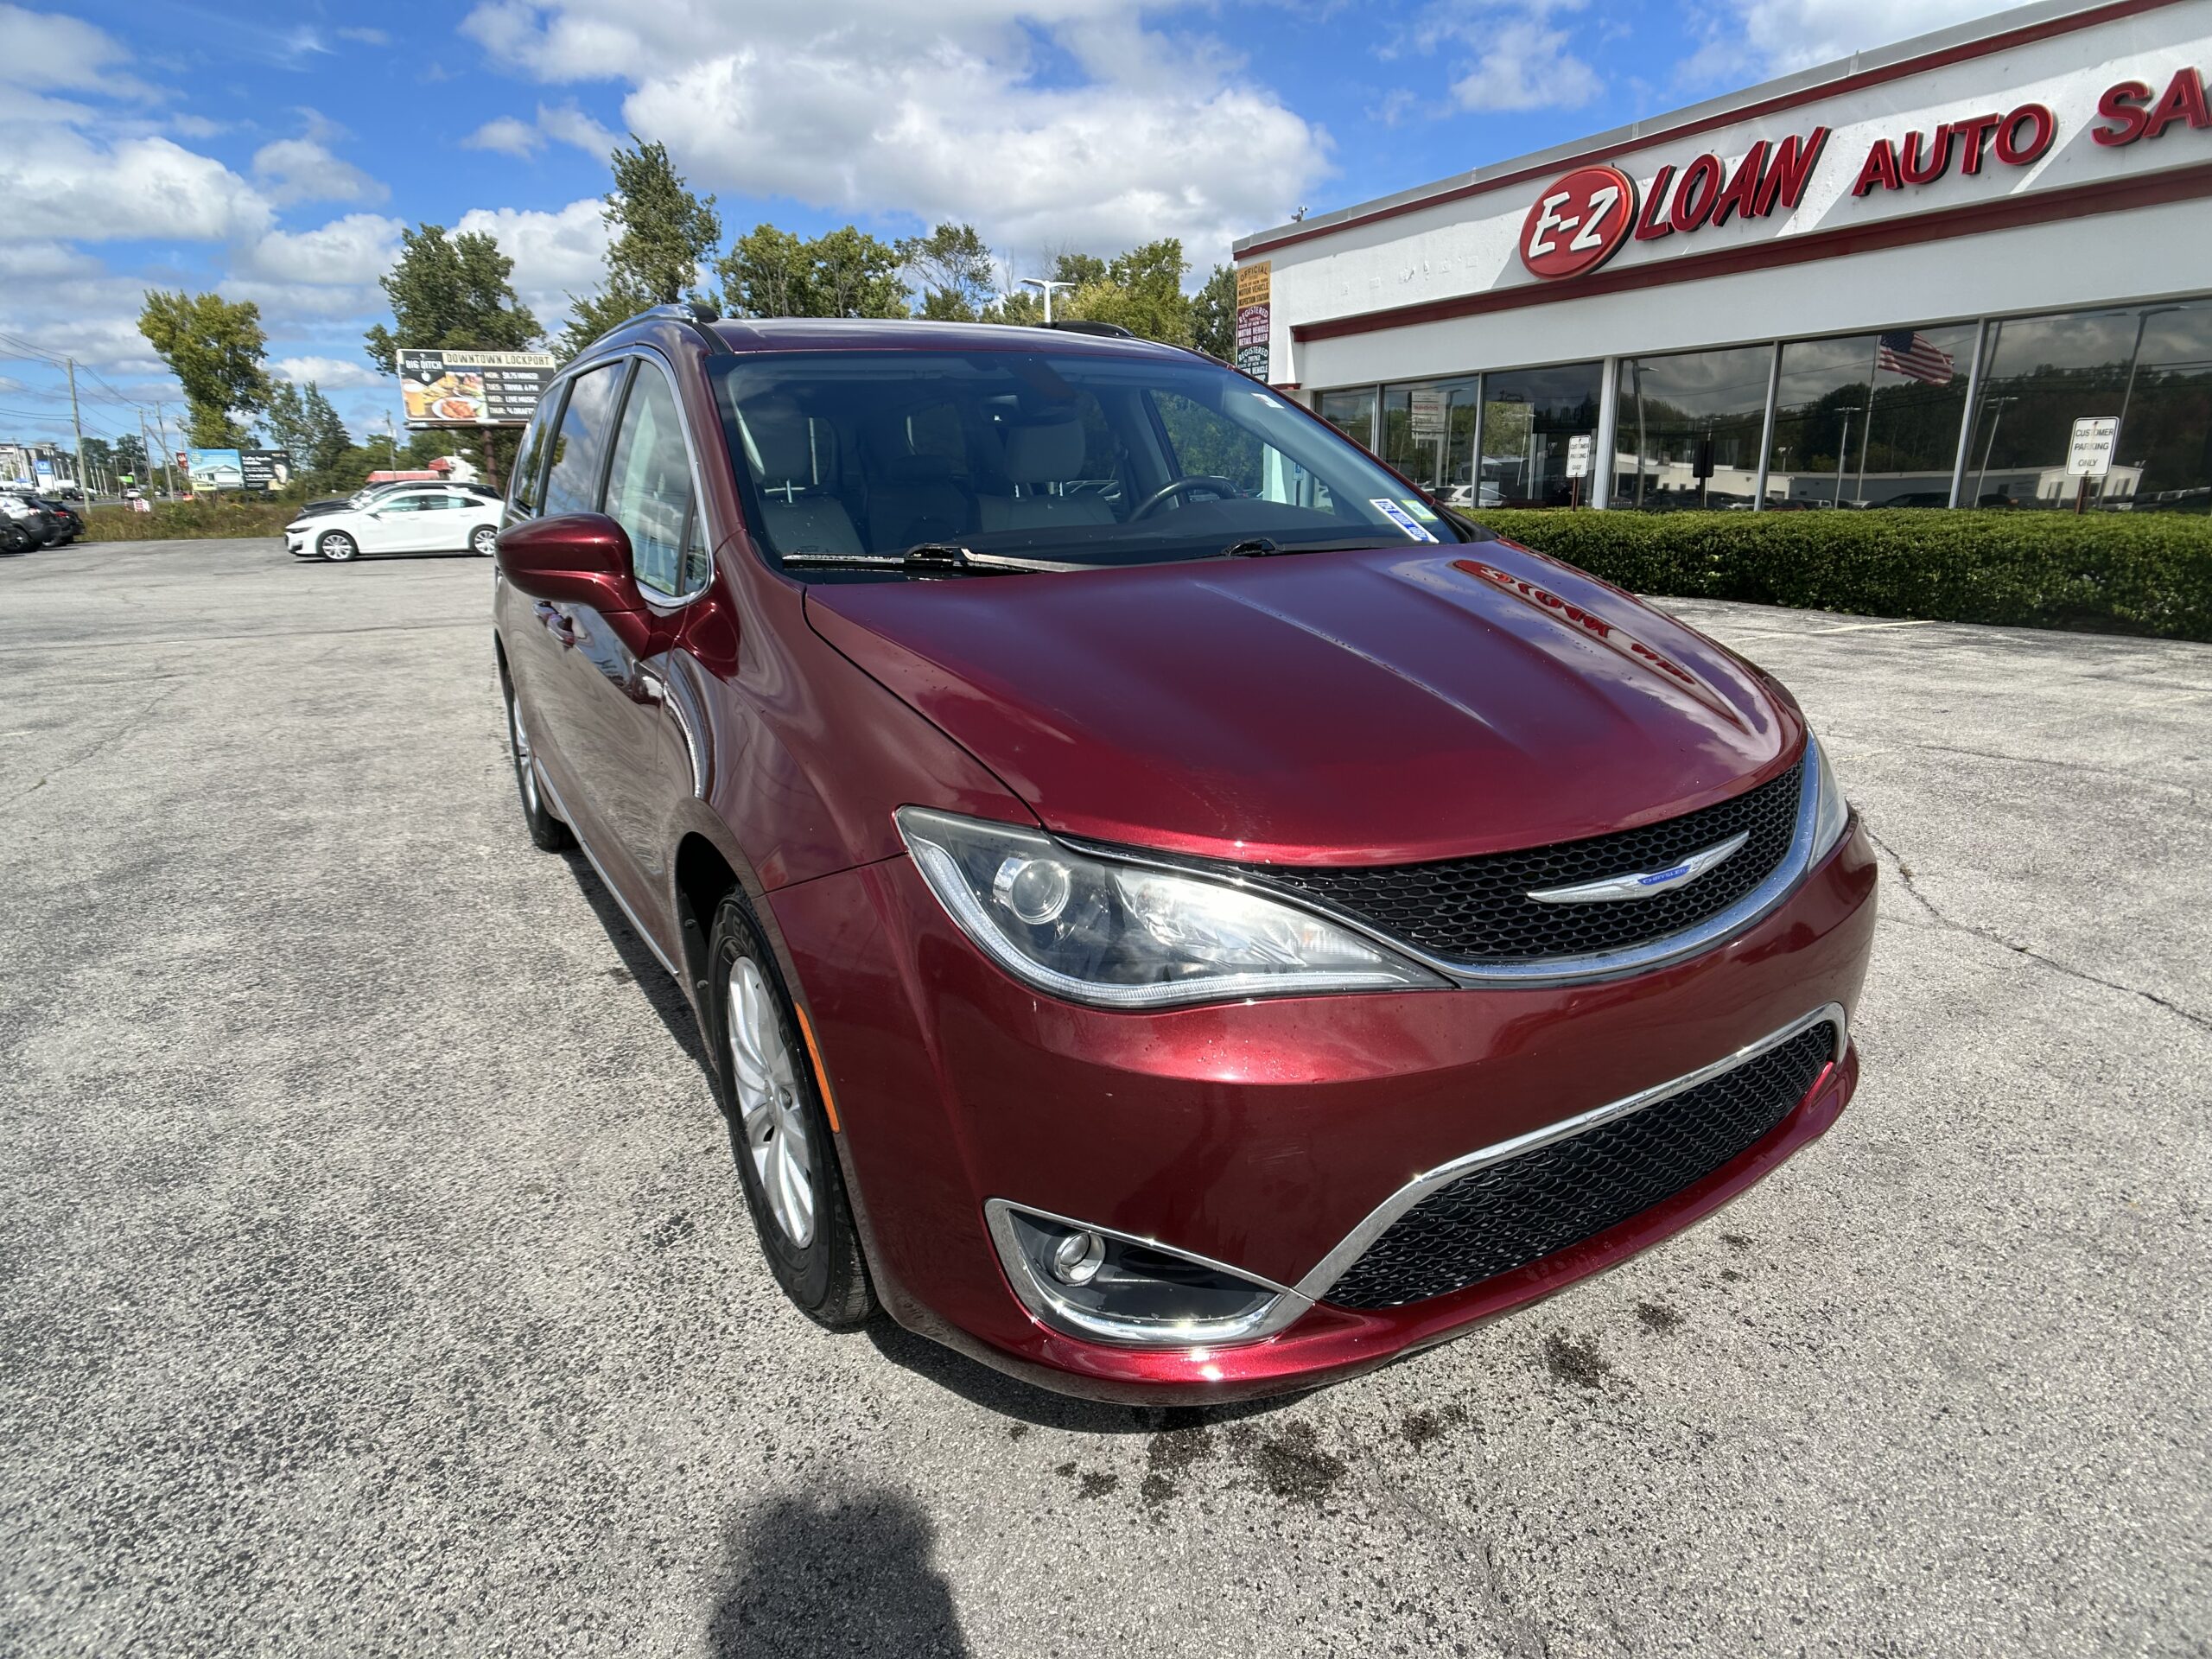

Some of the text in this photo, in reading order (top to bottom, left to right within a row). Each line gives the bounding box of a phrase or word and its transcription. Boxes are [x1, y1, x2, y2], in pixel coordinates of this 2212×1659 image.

[1529, 66, 2212, 258] E-Z LOAN AUTO SA
[1240, 265, 1268, 282] OFFICIAL
[1238, 283, 1268, 296] MOTOR VEHICLE
[1238, 292, 1268, 306] INSPECTION STATION
[1238, 306, 1268, 323] REGISTERED
[1238, 324, 1268, 338] MOTOR VEHICLE
[1238, 334, 1268, 346] RETAIL DEALER
[447, 353, 550, 365] DOWNTOWN LOCKPORT
[1238, 346, 1268, 362] REGISTERED
[405, 359, 443, 370] BIG DITCH
[1252, 365, 1268, 374] VEHICLE
[1643, 868, 1688, 883] CHRYSLER
